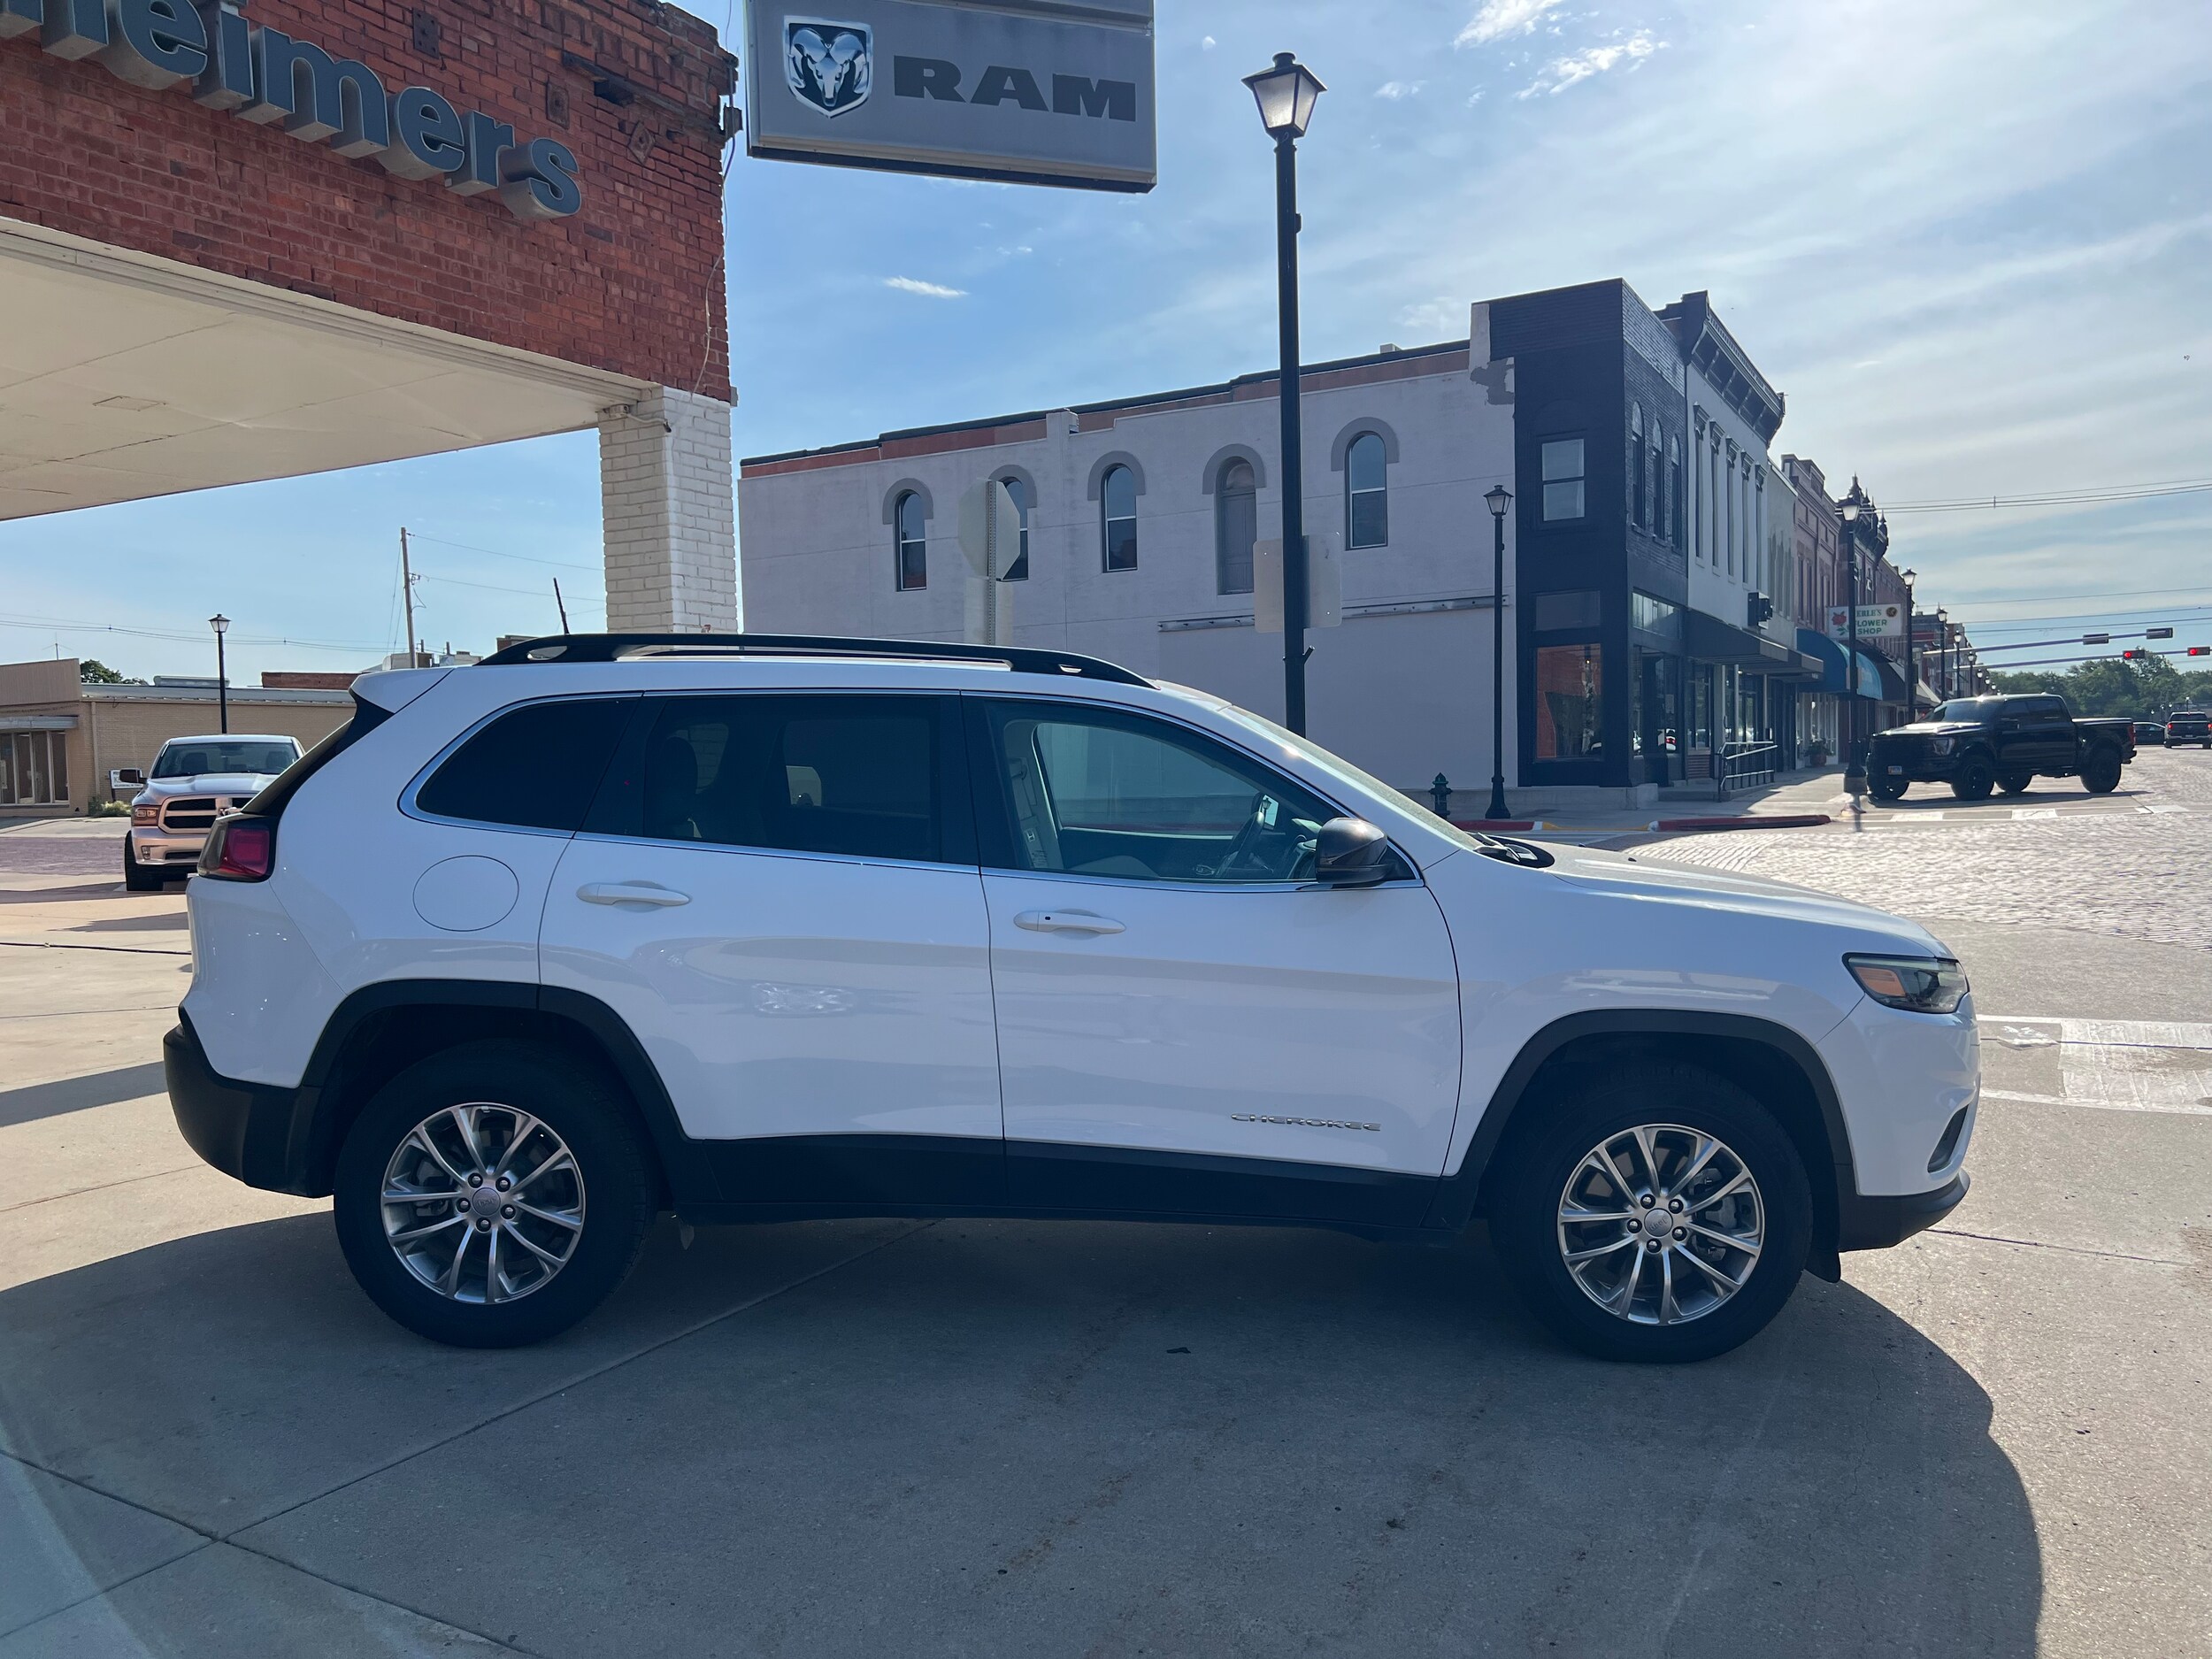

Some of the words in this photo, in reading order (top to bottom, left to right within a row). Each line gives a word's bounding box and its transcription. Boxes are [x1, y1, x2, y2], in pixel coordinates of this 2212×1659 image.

[893, 55, 1136, 122] RAM
[1855, 618, 1887, 627] LOWER
[1231, 1113, 1381, 1132] CHEROKEE
